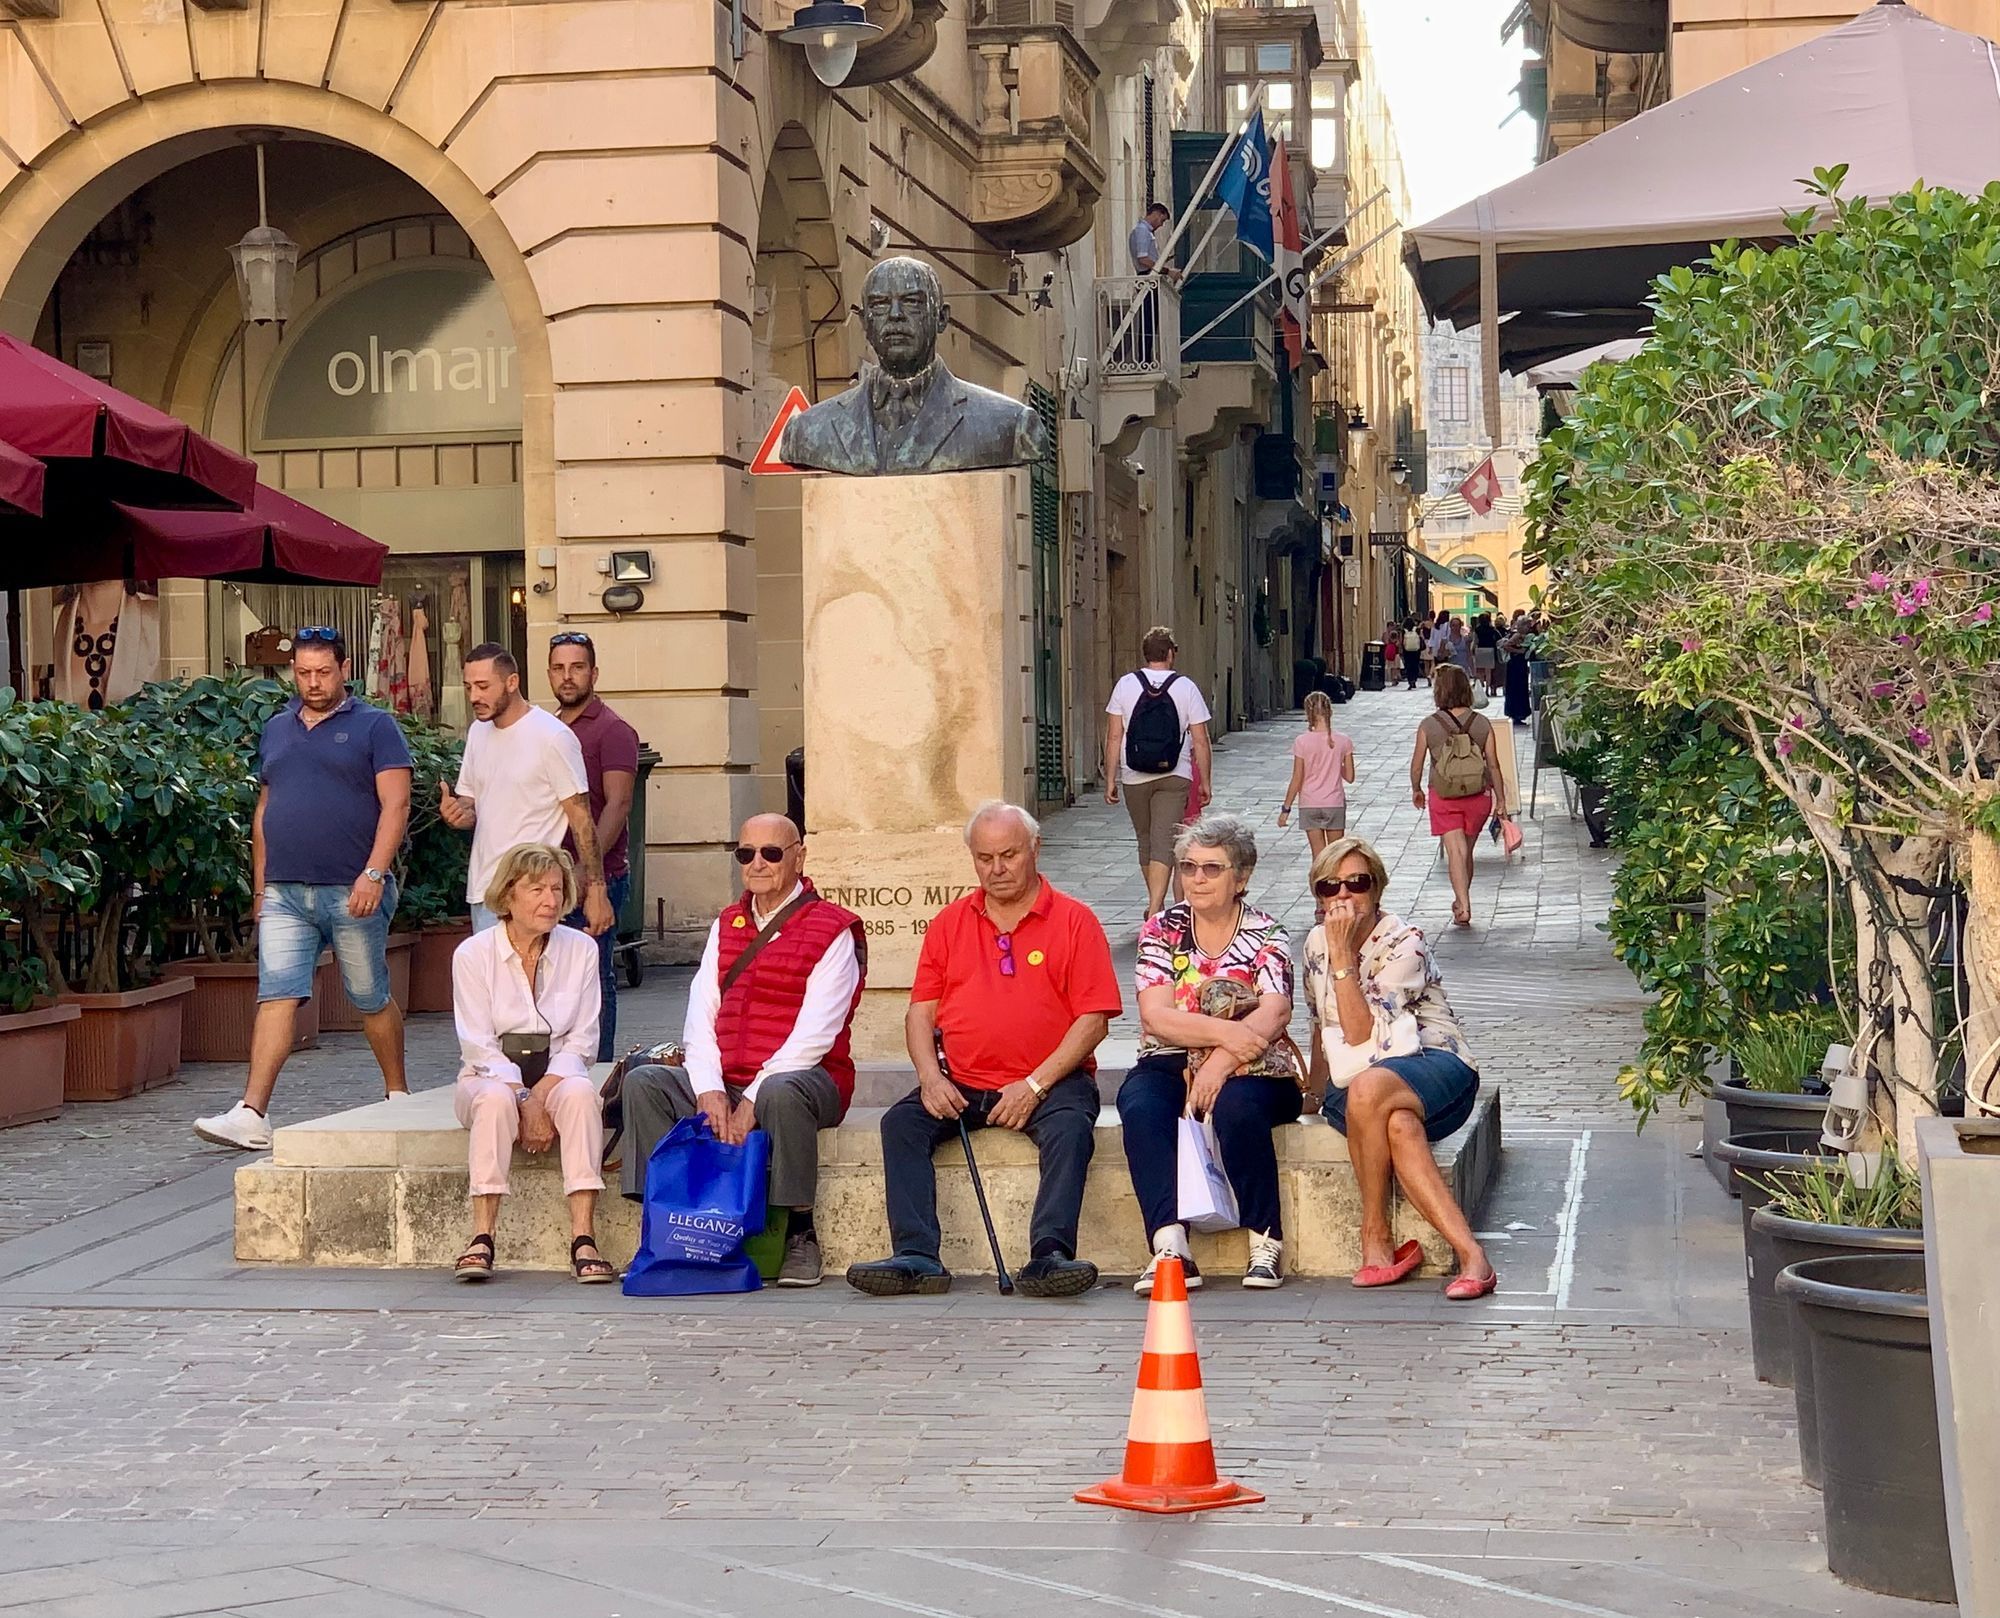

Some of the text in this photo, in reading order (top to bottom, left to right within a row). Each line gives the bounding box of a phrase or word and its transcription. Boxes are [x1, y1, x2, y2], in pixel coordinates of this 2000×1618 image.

[1371, 534, 1405, 543] FURLA
[822, 887, 912, 907] ENRICO
[865, 920, 894, 936] 885
[911, 919, 933, 935] 19
[668, 1212, 744, 1237] ELEGANZA
